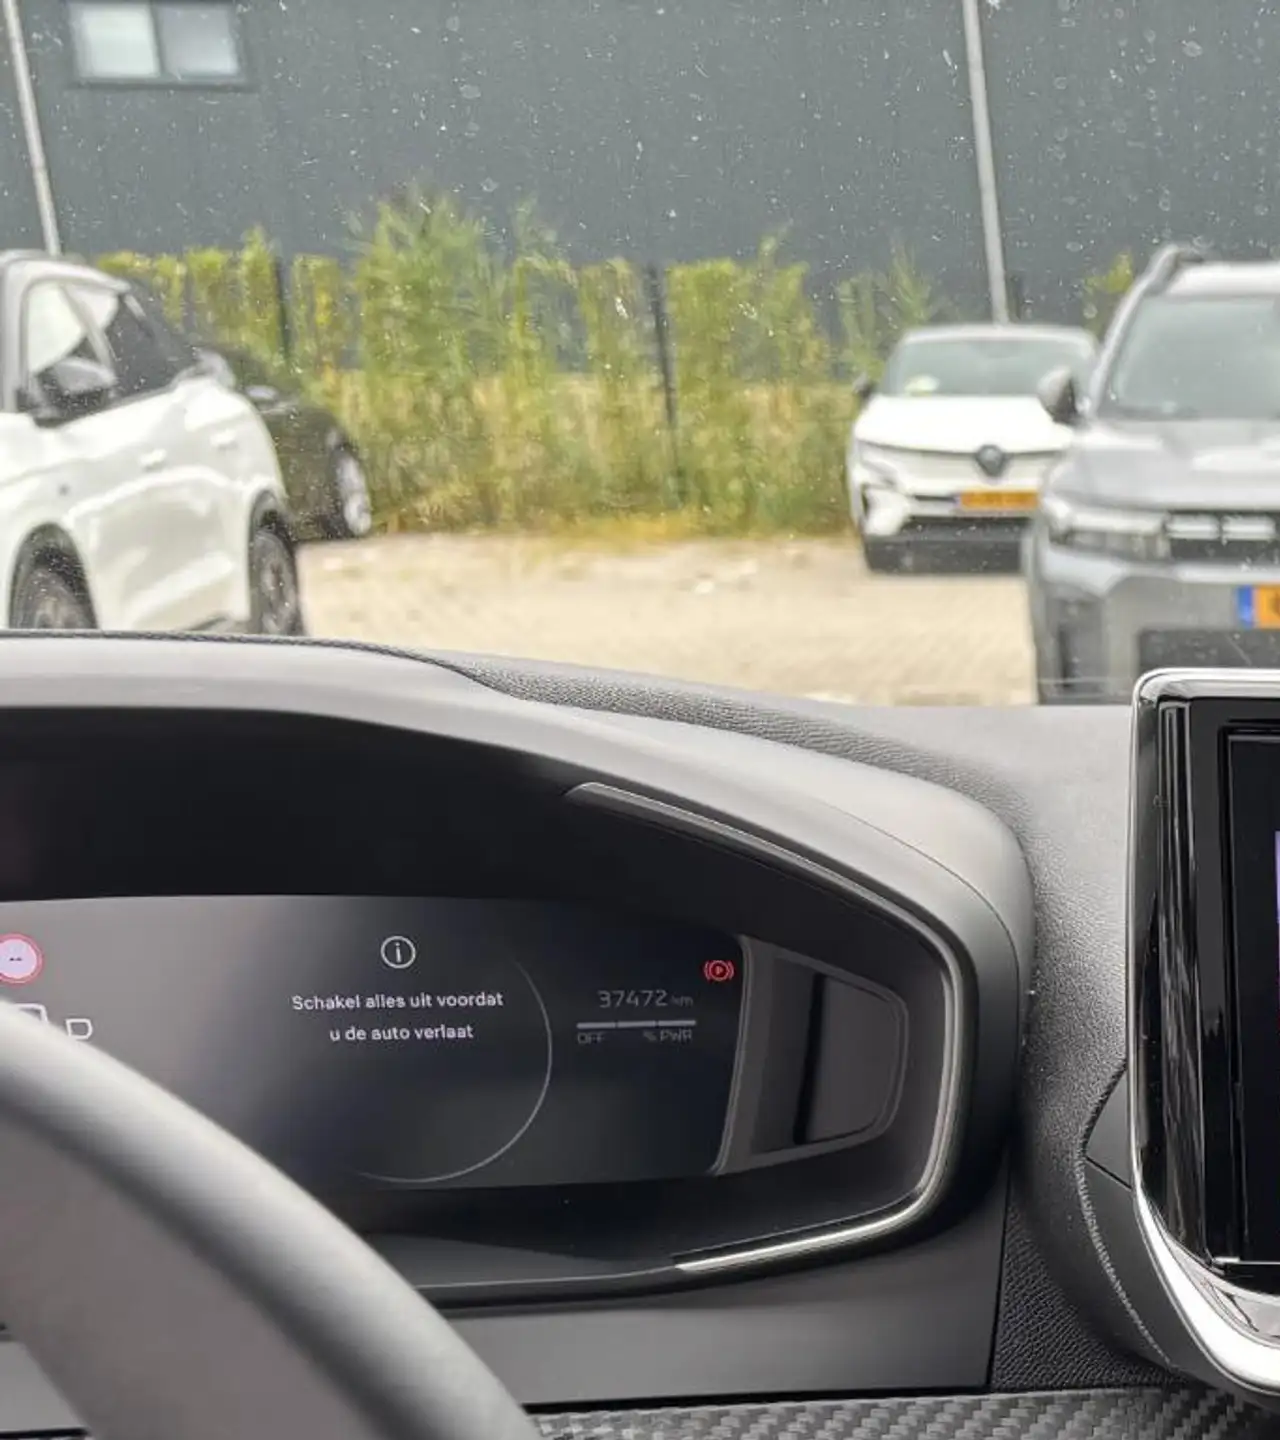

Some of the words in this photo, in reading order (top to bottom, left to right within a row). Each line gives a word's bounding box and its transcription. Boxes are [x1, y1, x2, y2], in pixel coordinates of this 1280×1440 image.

[292, 994, 361, 1011] Schakel
[366, 993, 406, 1009] alles
[410, 992, 433, 1008] uit
[437, 991, 504, 1008] voordat
[597, 989, 669, 1008] 37472
[329, 1030, 341, 1042] u
[345, 1025, 367, 1041] de
[371, 1026, 410, 1041] auto
[414, 1024, 474, 1040] verlaat
